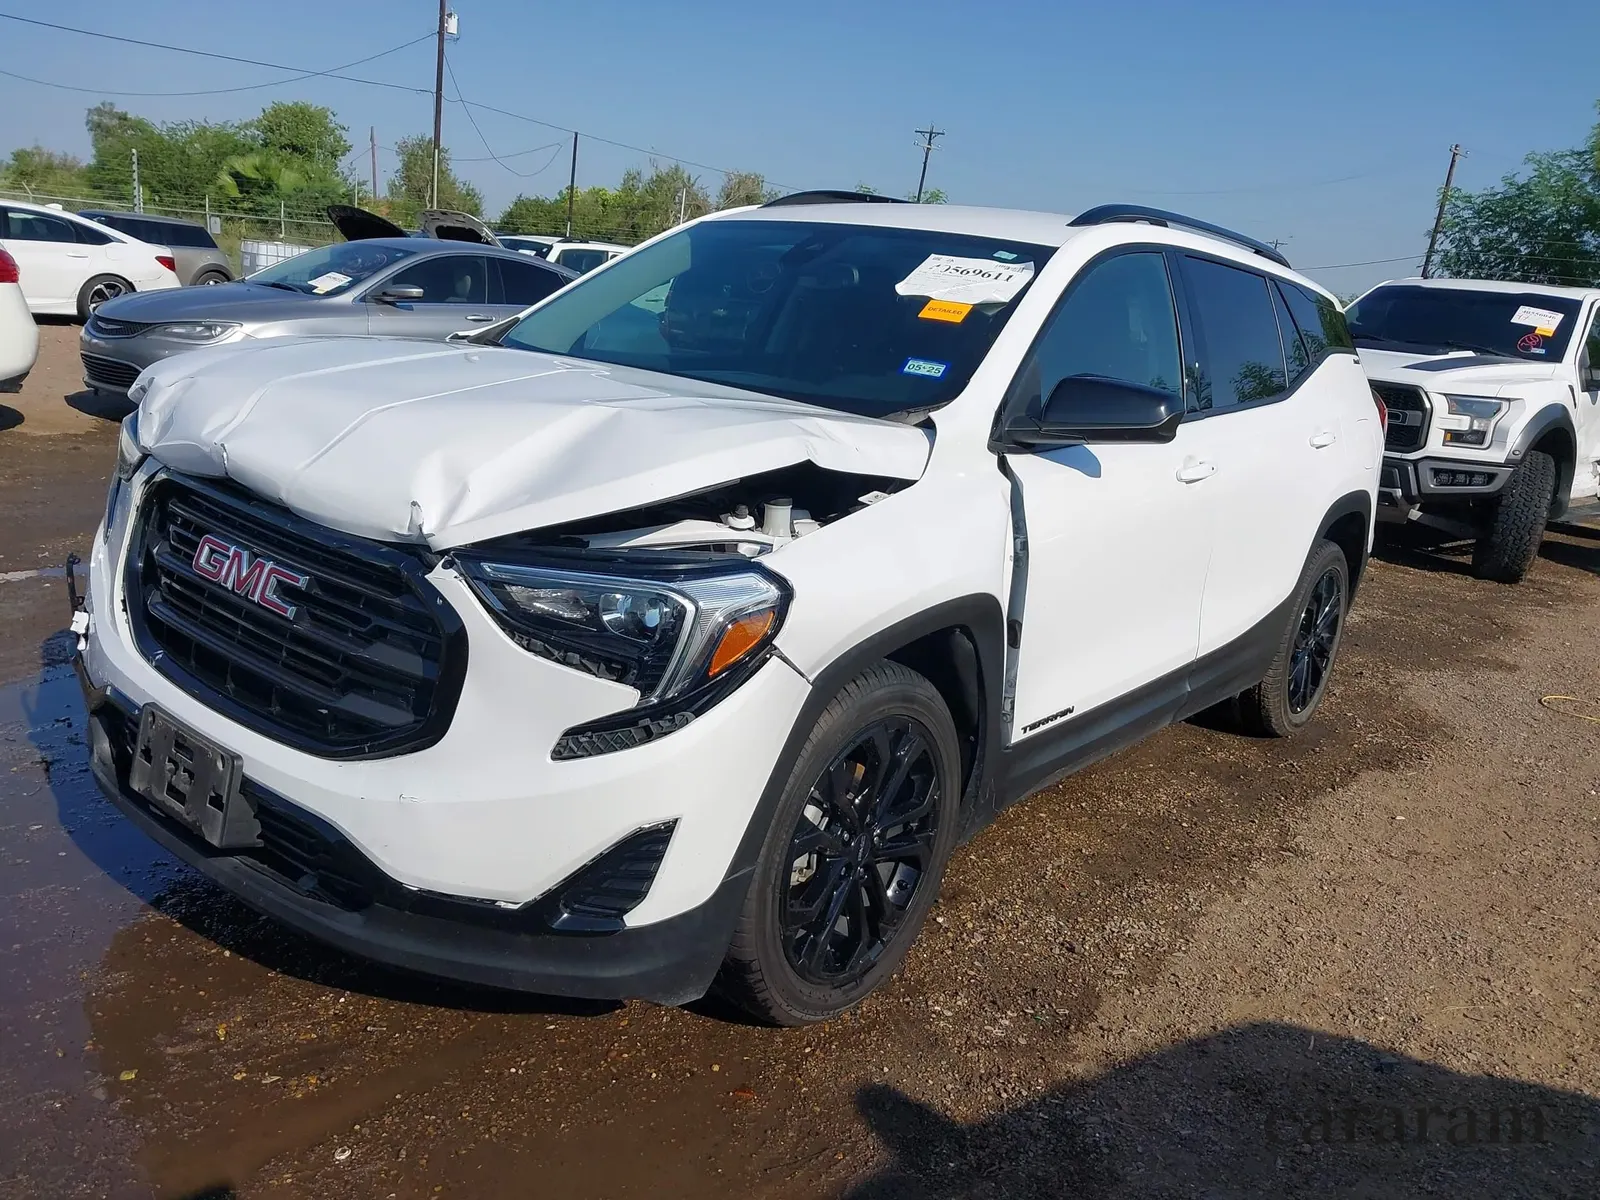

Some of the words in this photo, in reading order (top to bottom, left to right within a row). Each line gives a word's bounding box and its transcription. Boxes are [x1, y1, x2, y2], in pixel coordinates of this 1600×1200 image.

[927, 306, 963, 315] DETAILED
[192, 534, 309, 620] GMC
[1021, 705, 1075, 734] TERRAIN
